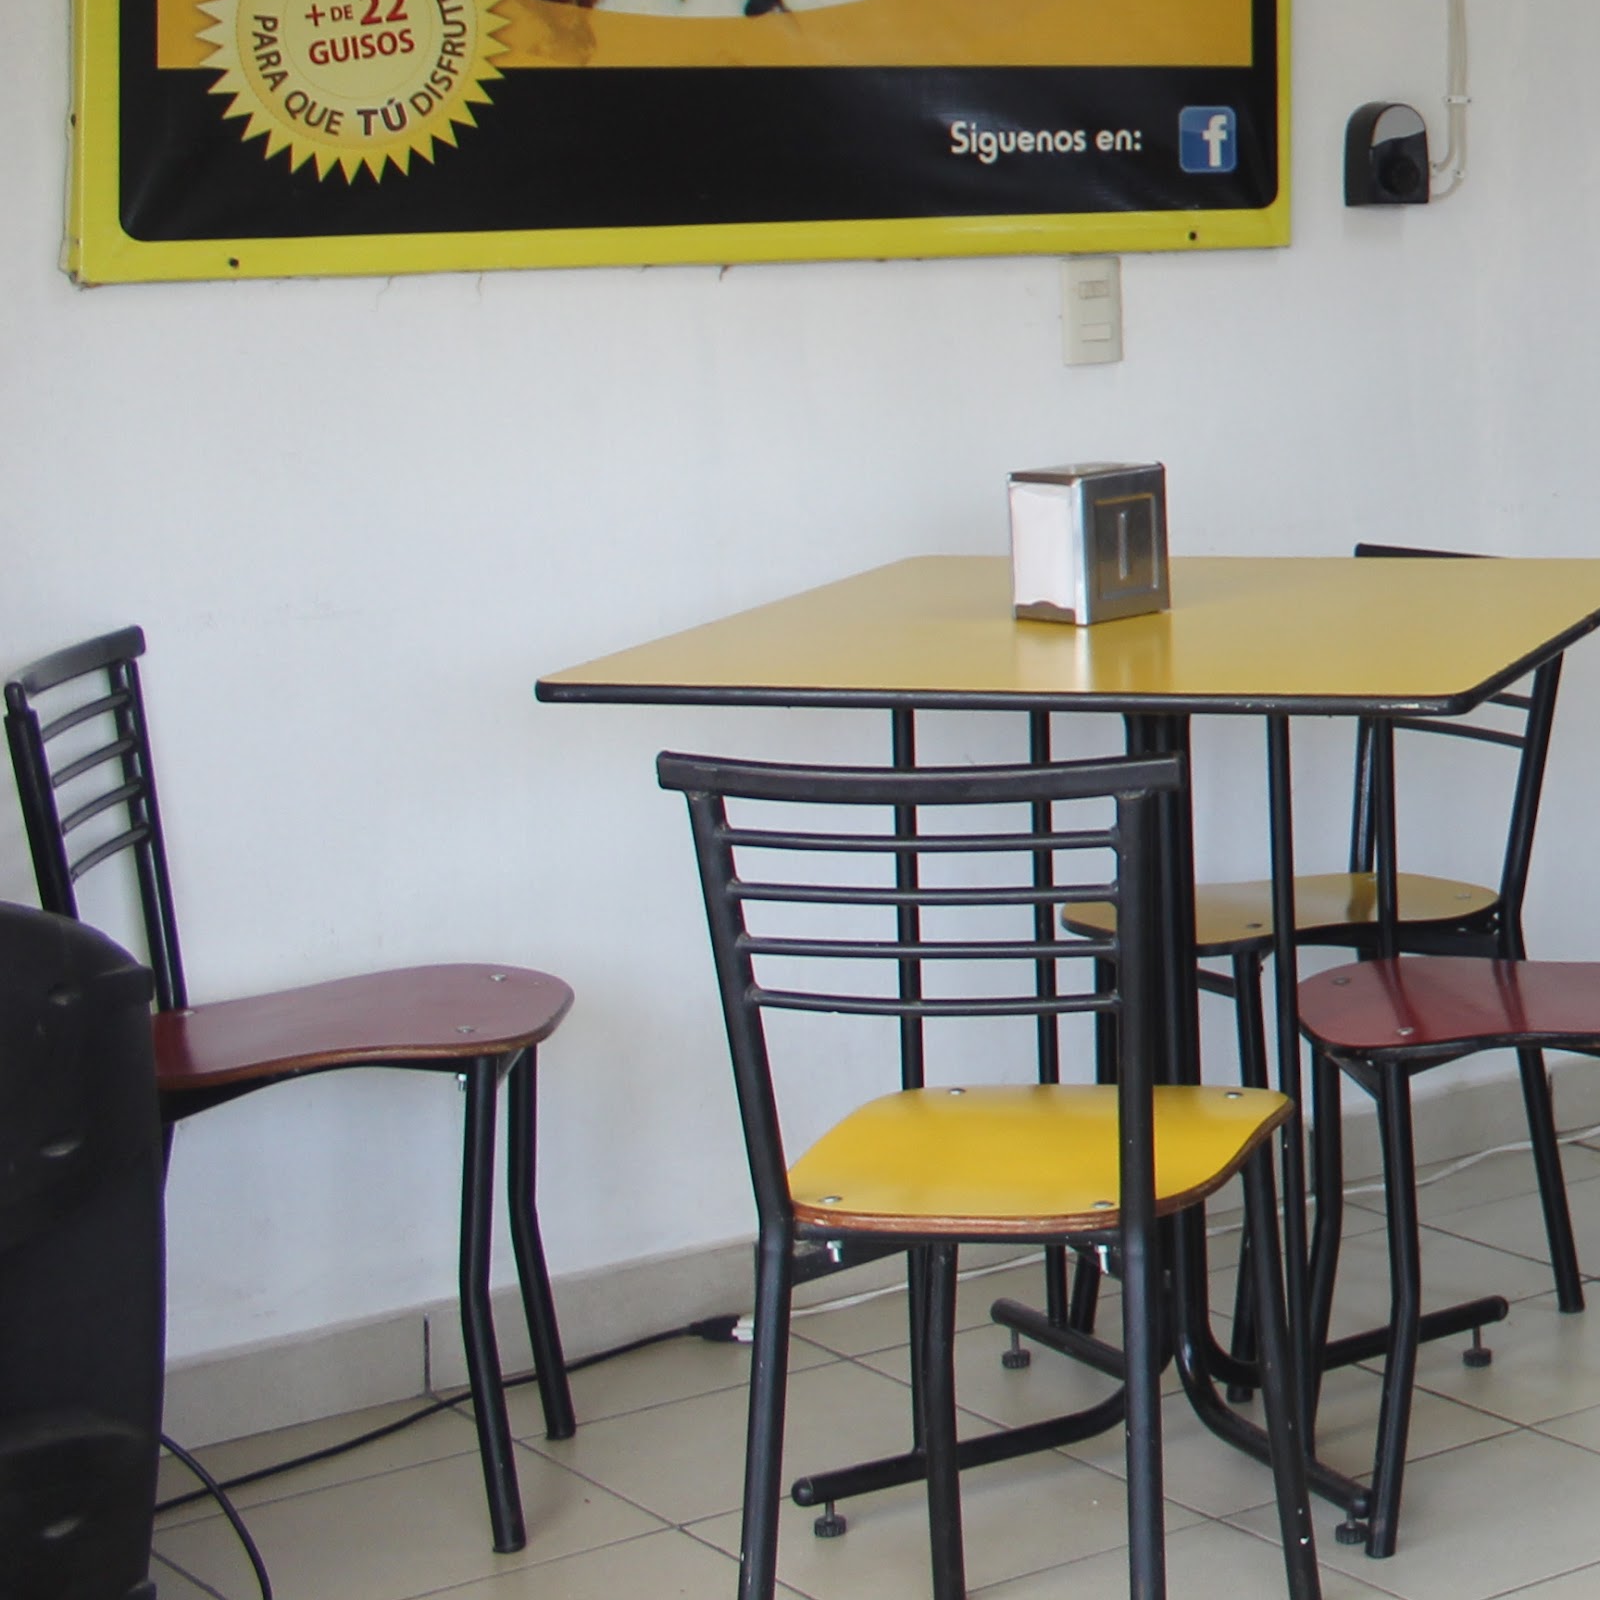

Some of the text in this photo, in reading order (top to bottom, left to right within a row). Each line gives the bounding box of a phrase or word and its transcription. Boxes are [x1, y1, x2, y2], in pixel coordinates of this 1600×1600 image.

[331, 4, 354, 23] DE
[309, 28, 415, 65] GUISOS
[252, 14, 289, 93] PARA
[284, 90, 344, 136] QUE
[357, 98, 408, 136] TÚ
[1096, 129, 1142, 151] en:
